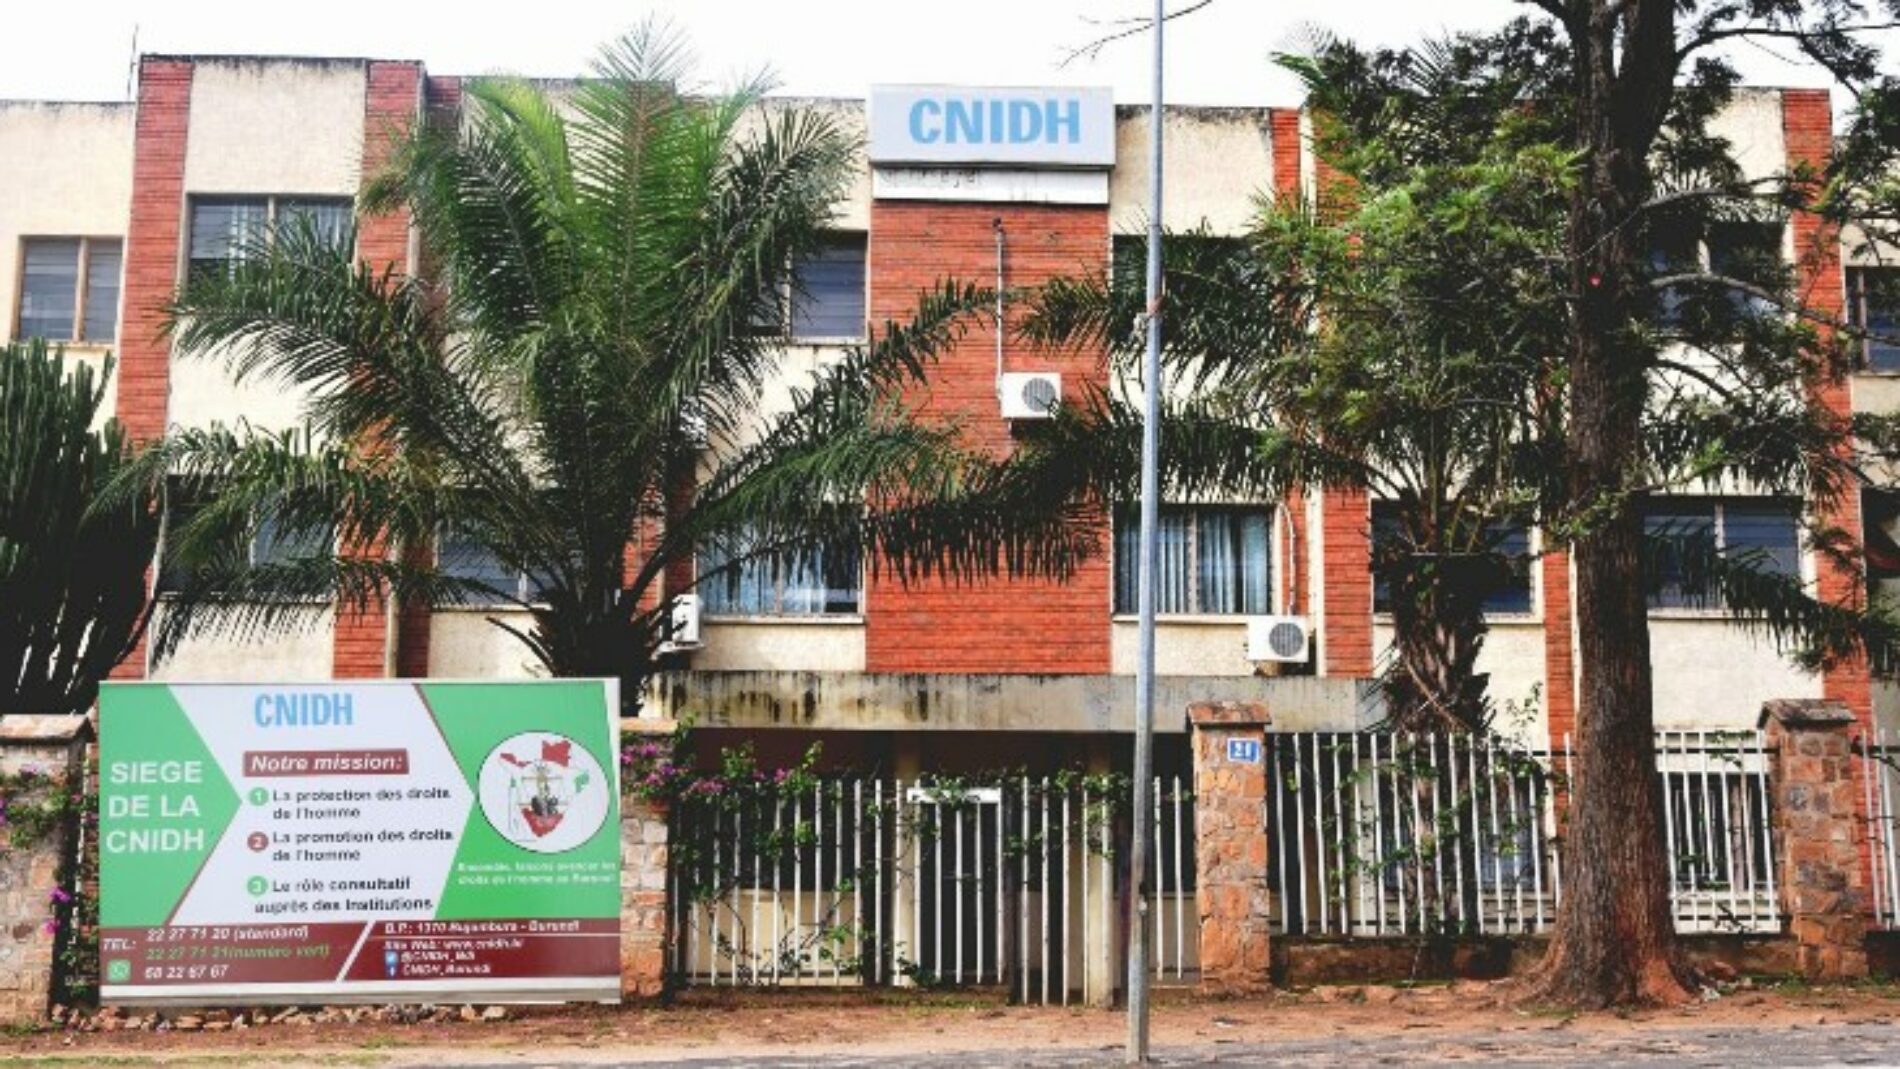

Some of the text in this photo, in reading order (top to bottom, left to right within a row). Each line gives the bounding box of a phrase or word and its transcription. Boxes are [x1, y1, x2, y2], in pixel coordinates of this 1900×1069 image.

[909, 98, 1080, 143] CNIDH
[254, 693, 353, 727] CNIDH
[251, 753, 403, 771] Notre mission:
[110, 760, 203, 783] SIEGE
[273, 787, 450, 804] La protection des droits
[108, 795, 200, 817] DE LA
[273, 808, 290, 819] de
[106, 829, 204, 853] CNIDH
[273, 829, 453, 845] La promotion des droits
[273, 850, 290, 861] de
[273, 876, 410, 892] Le rôle consultatif
[255, 897, 432, 914] auprès des Institutions
[146, 928, 165, 942] 22
[169, 928, 186, 940] 27
[190, 928, 207, 940] 71
[233, 925, 309, 941] (standard)
[103, 938, 136, 950] TEL:
[166, 966, 184, 979] 22
